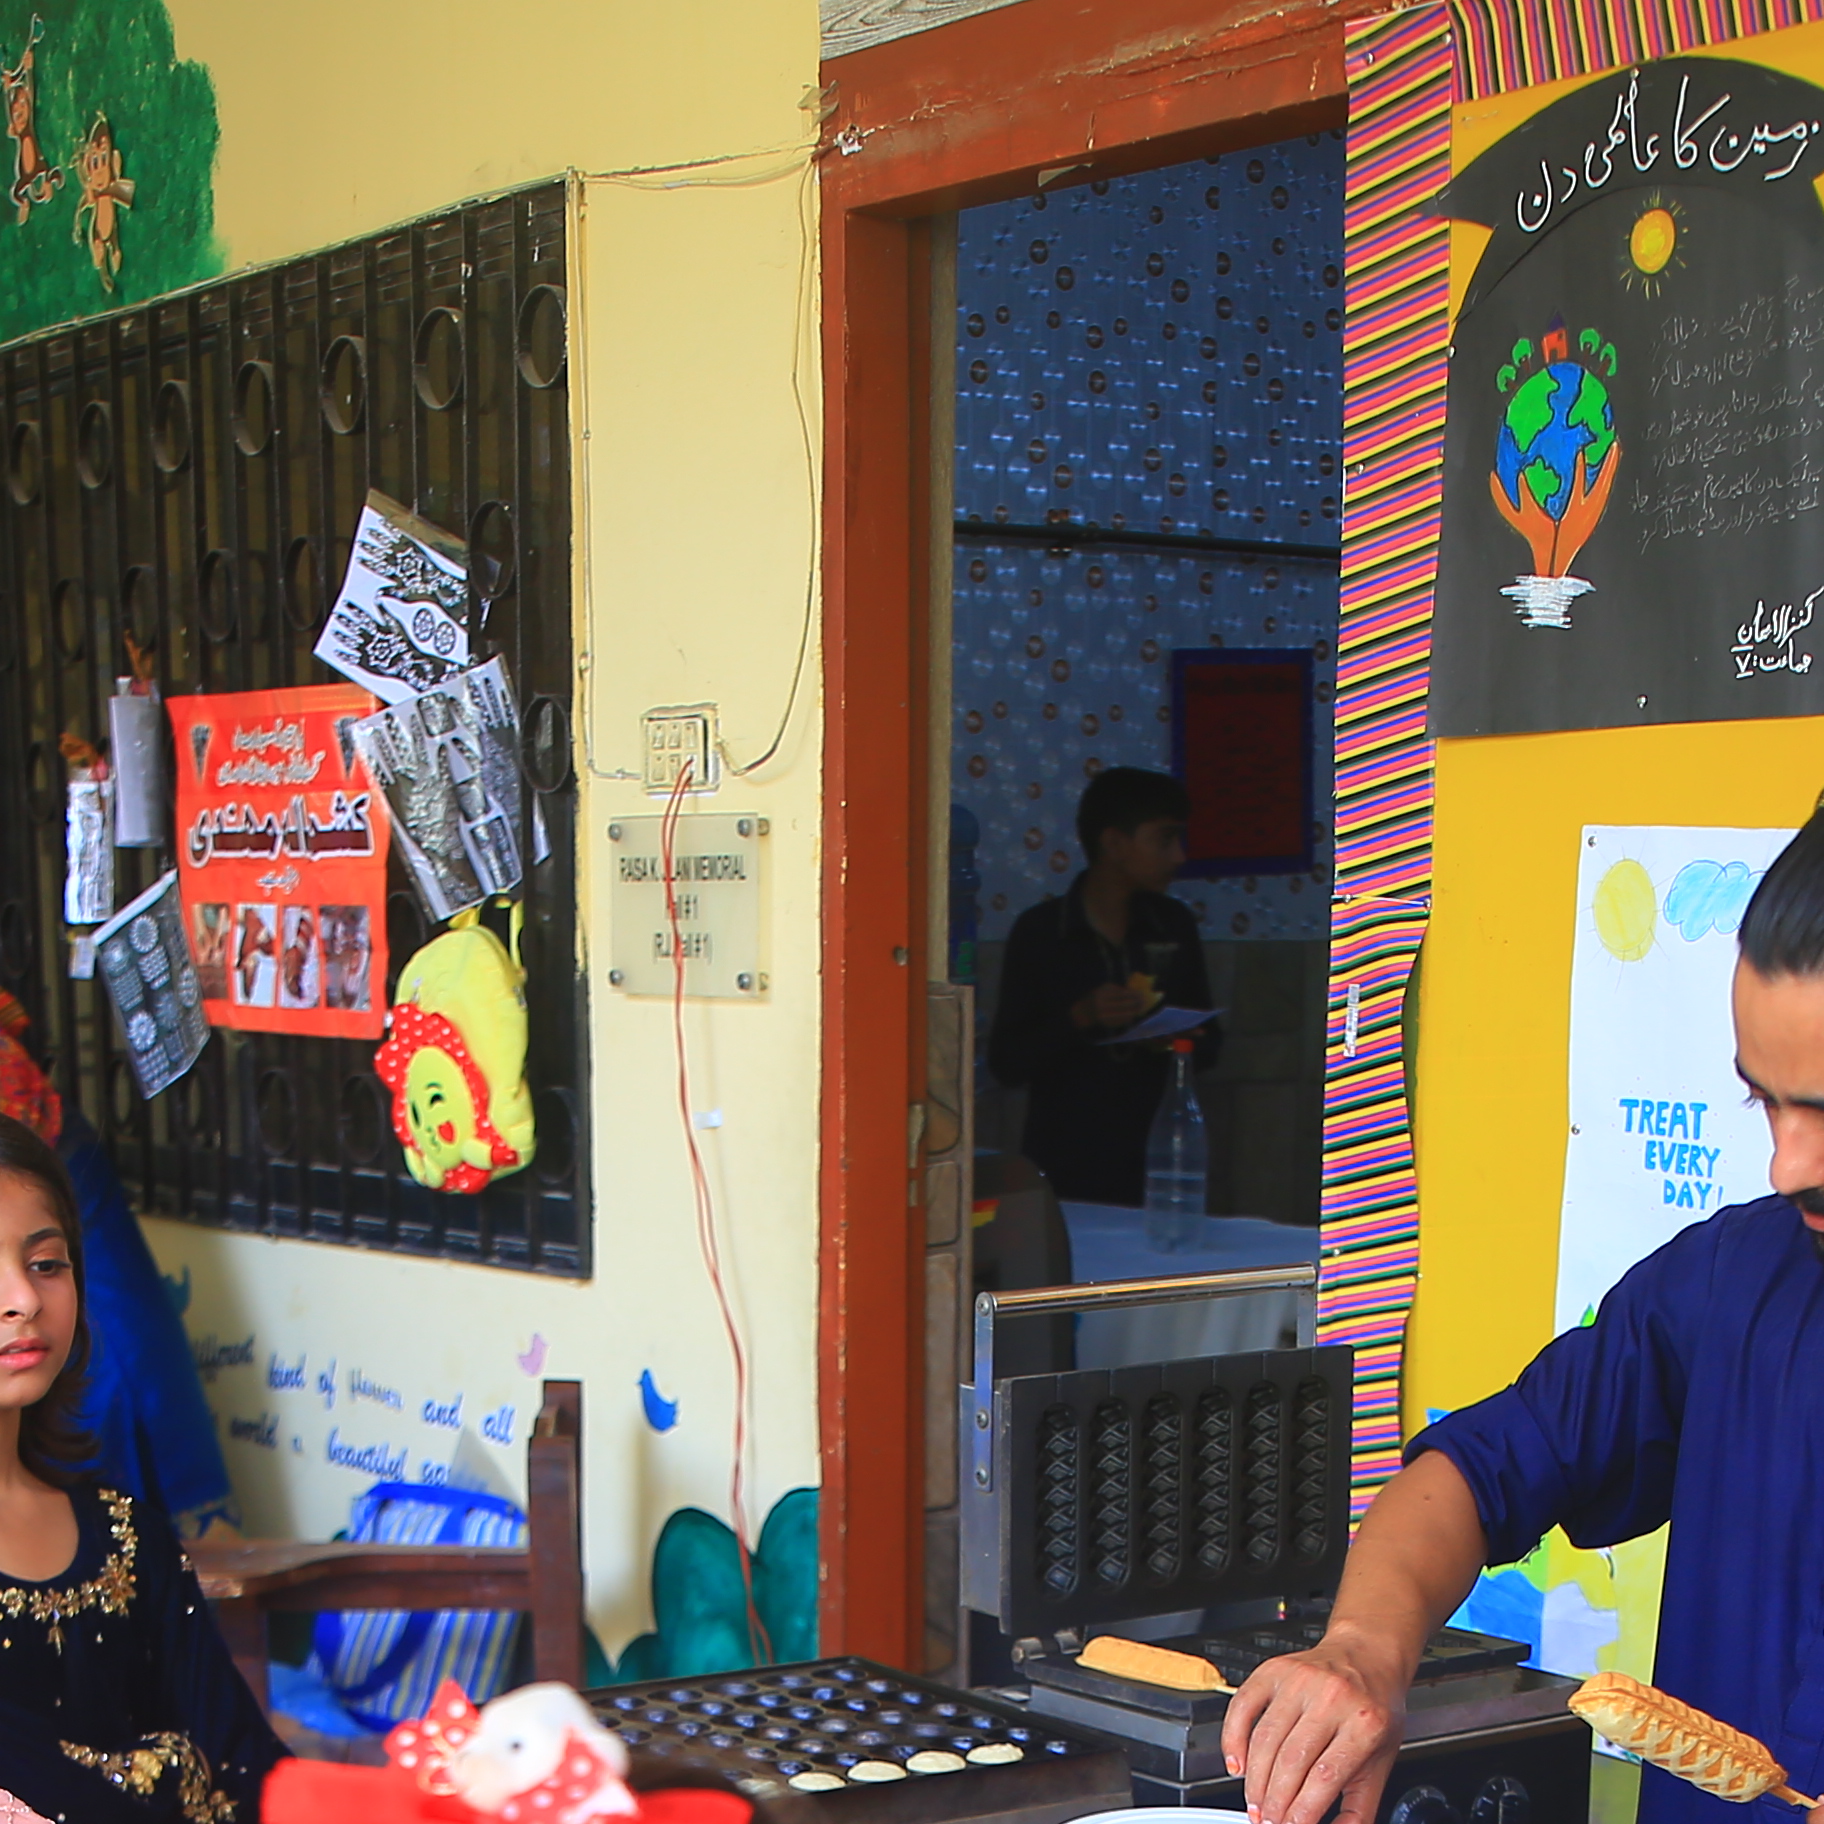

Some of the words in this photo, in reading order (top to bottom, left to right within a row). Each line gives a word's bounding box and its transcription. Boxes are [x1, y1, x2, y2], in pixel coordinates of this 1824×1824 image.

[1673, 74, 1731, 169] کا
[1516, 159, 1578, 232] دن
[1619, 1099, 1707, 1139] TREAT
[1644, 1140, 1721, 1178] EVERY
[422, 1393, 463, 1429] and
[482, 1406, 516, 1444] all
